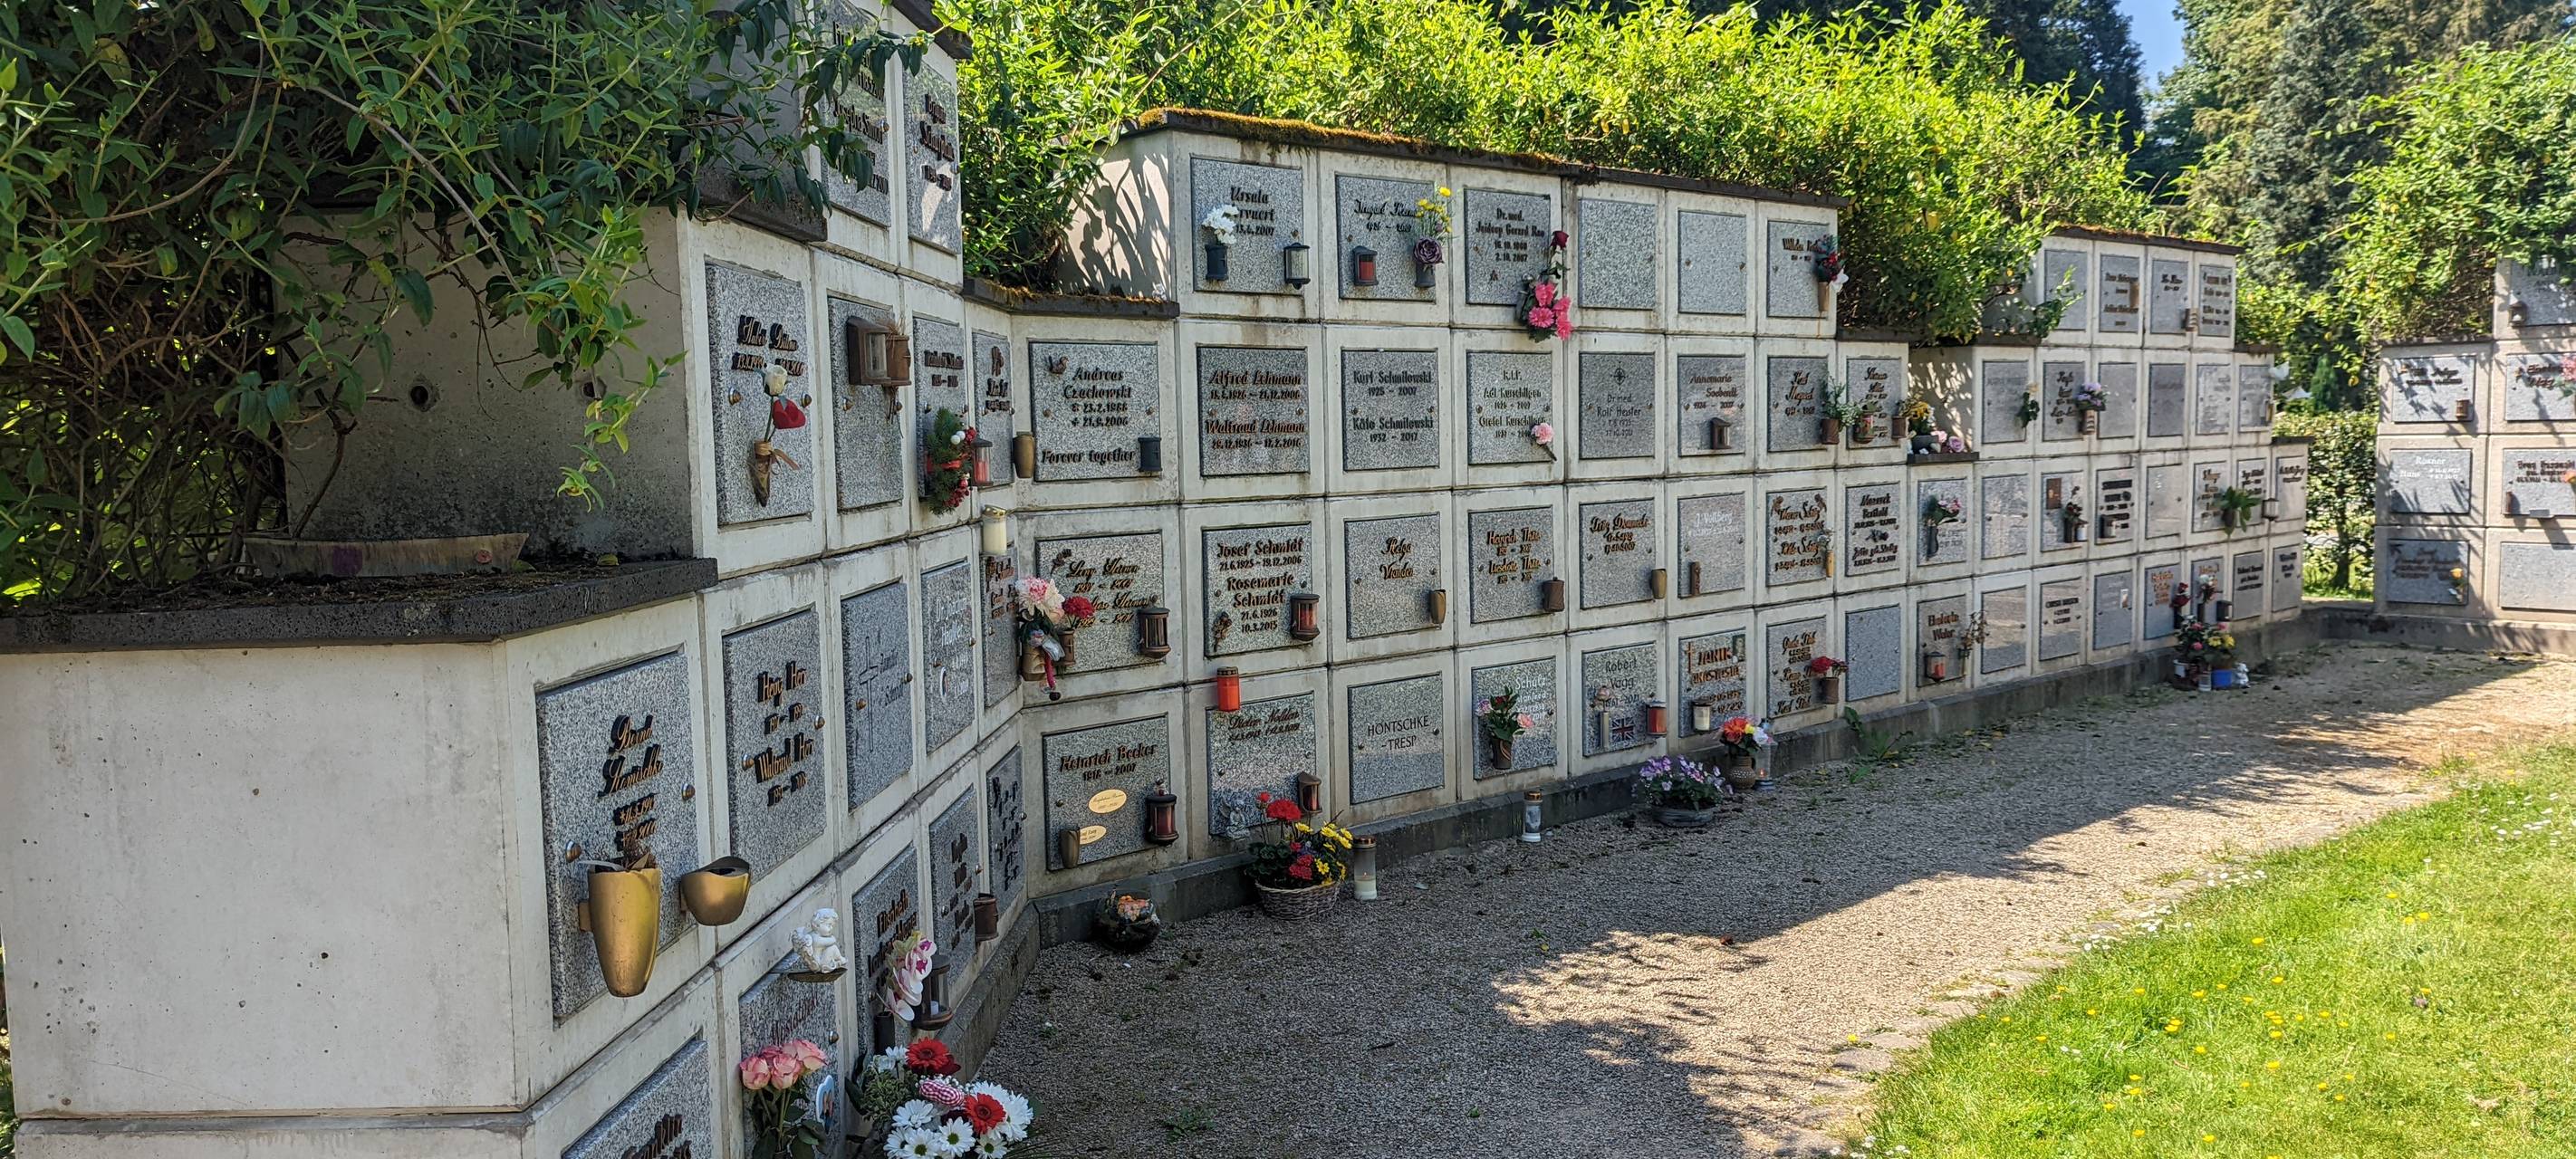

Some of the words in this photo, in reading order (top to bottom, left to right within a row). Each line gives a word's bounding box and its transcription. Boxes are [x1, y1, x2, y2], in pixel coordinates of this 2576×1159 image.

[1496, 208, 1508, 220] Dr.
[1509, 209, 1524, 222] med.
[1072, 368, 1124, 380] Andreas
[1209, 369, 1249, 388] Alfred
[1253, 370, 1302, 386] Lehmann
[1353, 371, 1374, 384] Kurt
[1379, 370, 1431, 383] Schmilowski
[1063, 385, 1132, 399] Czachowski
[1205, 419, 1258, 435] Waltraud
[1260, 418, 1305, 434] Lehmann
[1379, 417, 1433, 430] Schmilowski
[1042, 449, 1084, 464] Forever
[1089, 447, 1135, 465] together
[1217, 542, 1251, 558] Josef
[1254, 538, 1304, 555] Schmidt
[1227, 571, 1294, 591] Rosemarie
[1233, 589, 1285, 608] Schmidt
[1060, 748, 1111, 772] Heinrich
[1118, 742, 1158, 761] Becker
